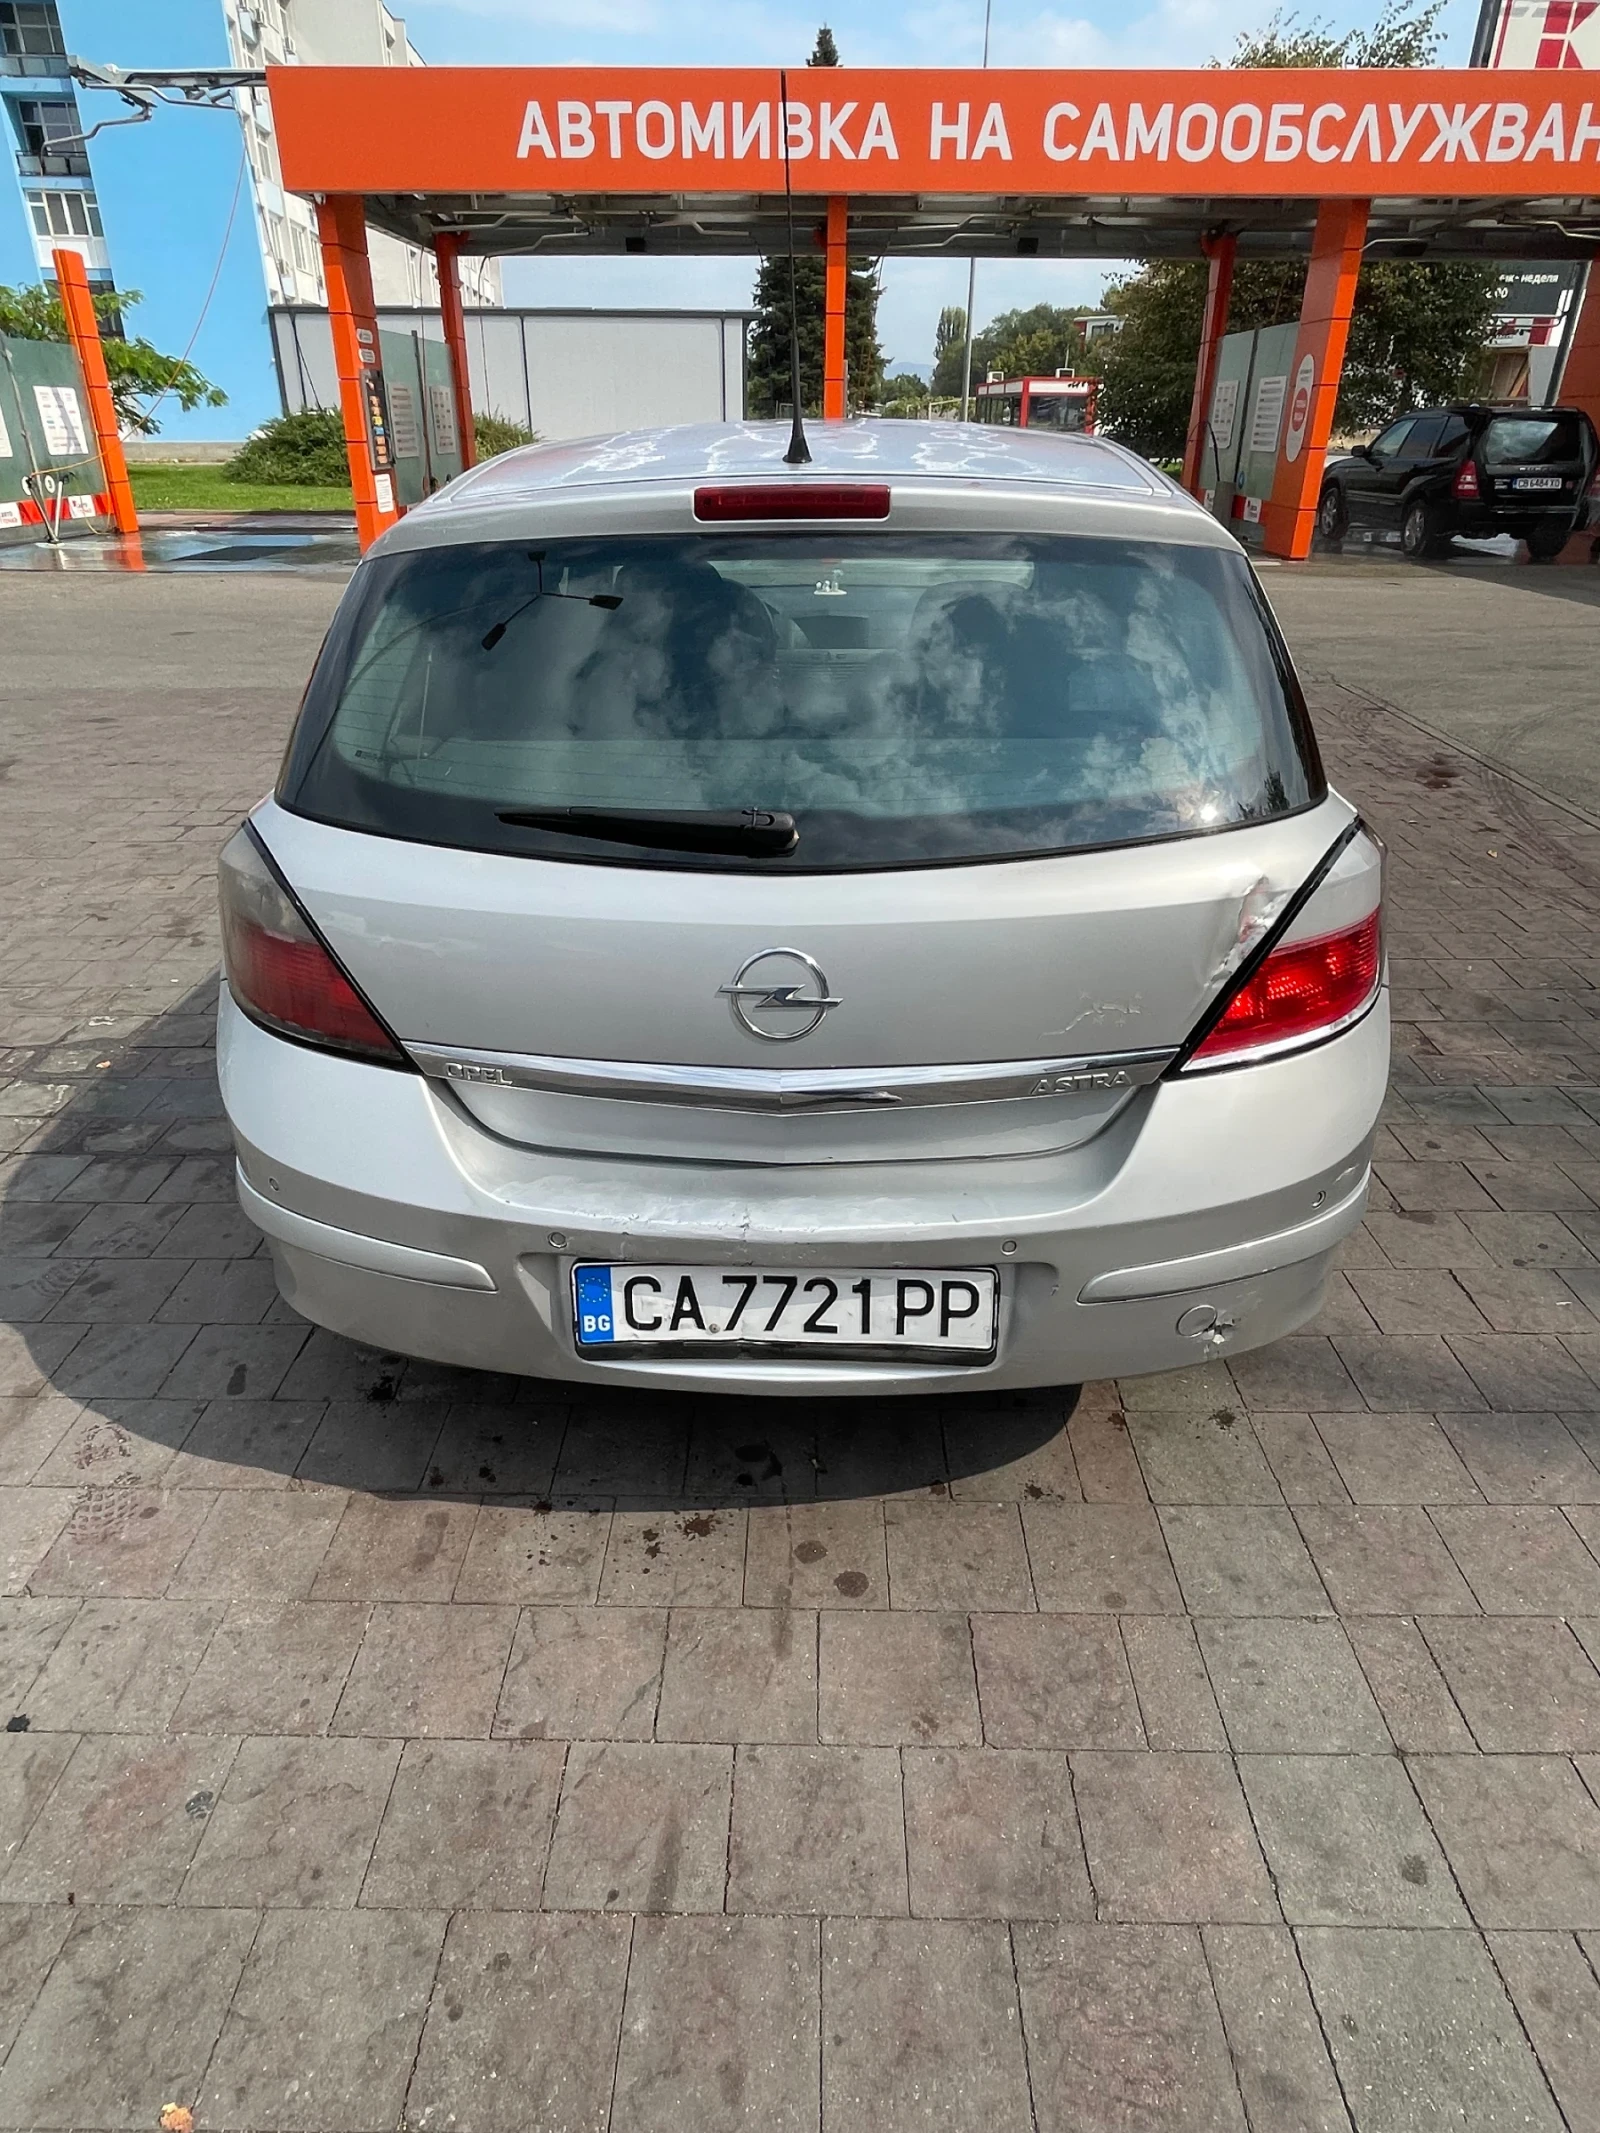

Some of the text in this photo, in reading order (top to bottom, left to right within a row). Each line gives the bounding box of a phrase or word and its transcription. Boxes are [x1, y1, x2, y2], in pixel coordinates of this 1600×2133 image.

[516, 101, 899, 159] АВТОМИВКА
[929, 102, 1013, 159] НА
[444, 1062, 513, 1085] OPEL
[1030, 1071, 1132, 1095] ASTRA
[583, 1315, 611, 1332] BG
